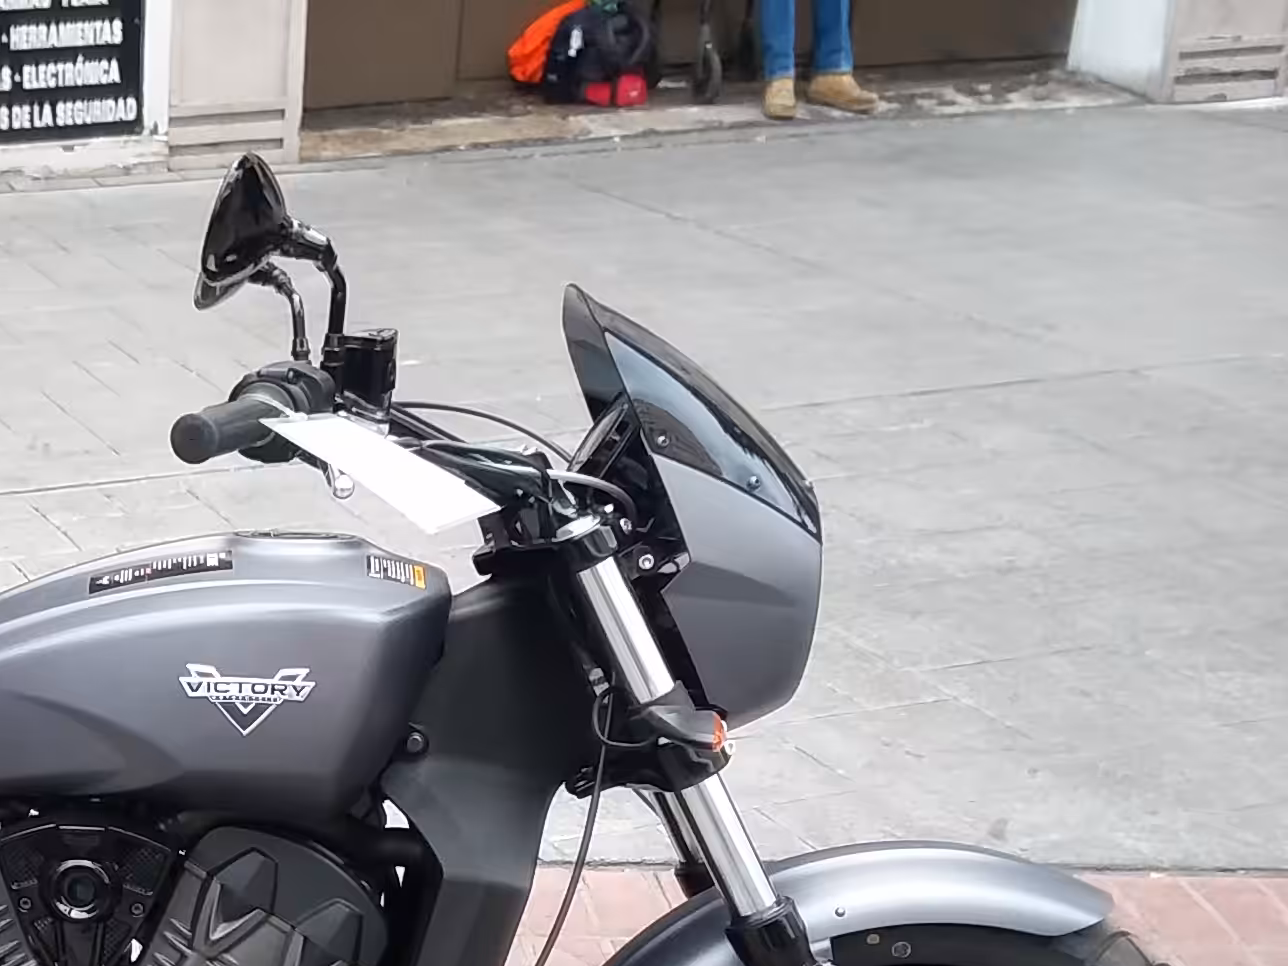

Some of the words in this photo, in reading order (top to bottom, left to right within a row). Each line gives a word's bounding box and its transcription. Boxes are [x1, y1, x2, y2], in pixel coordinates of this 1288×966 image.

[9, 17, 124, 51] HERRAMIENTAS
[22, 53, 121, 90] ELECTRÓNICA
[12, 103, 31, 130] DE
[33, 101, 54, 128] LA
[56, 96, 137, 126] SEGURIDAD
[185, 681, 308, 697] VICTORY
